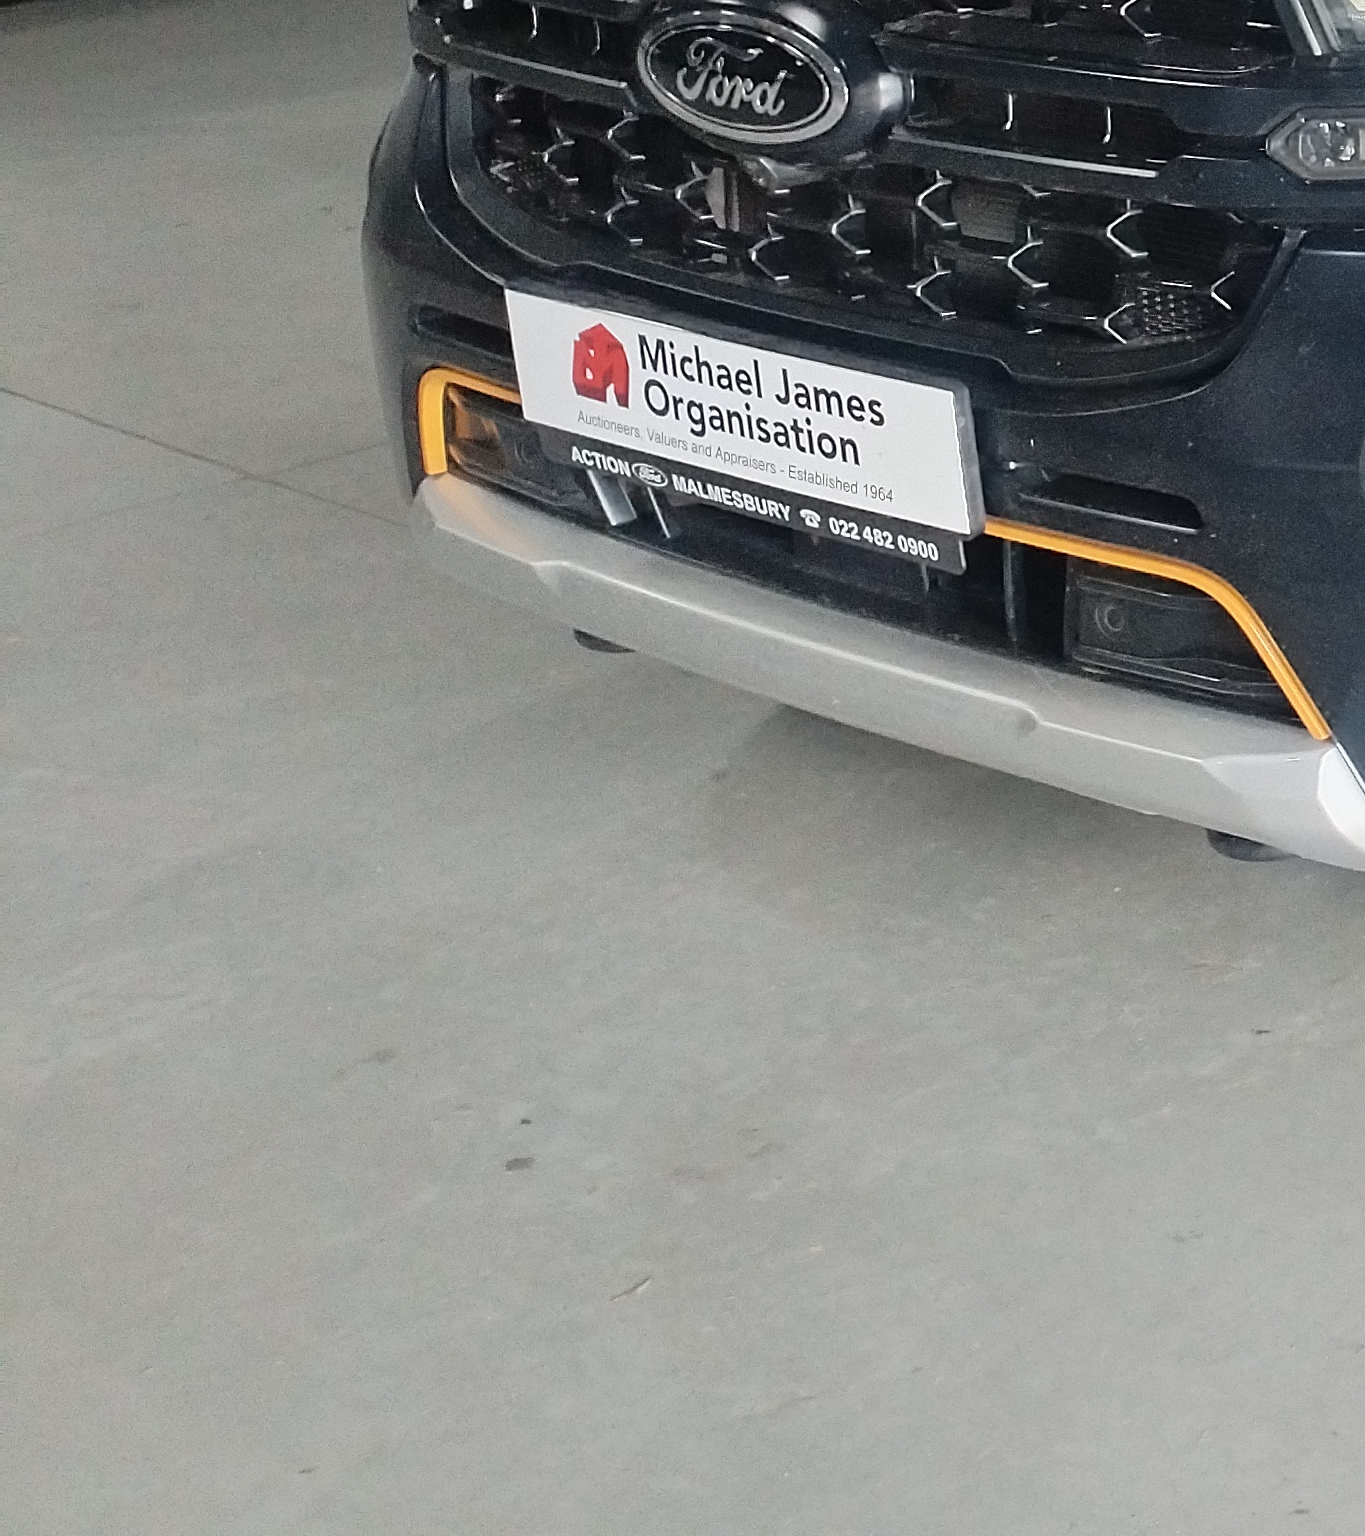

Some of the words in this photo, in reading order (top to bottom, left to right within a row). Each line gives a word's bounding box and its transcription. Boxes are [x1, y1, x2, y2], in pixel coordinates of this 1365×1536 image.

[676, 37, 789, 117] Ford
[638, 334, 763, 398] Michael
[775, 368, 886, 426] James
[644, 379, 861, 466] Organisation
[571, 446, 630, 477] ACTION
[671, 474, 791, 522] MALMESBURY
[829, 517, 860, 541] 022
[862, 526, 895, 550] 482
[897, 534, 939, 561] 0900
[647, 428, 689, 451] Valuers
[691, 441, 712, 458] and
[715, 446, 777, 474] Appraisers
[788, 464, 858, 495] Established
[862, 482, 894, 503] 1964
